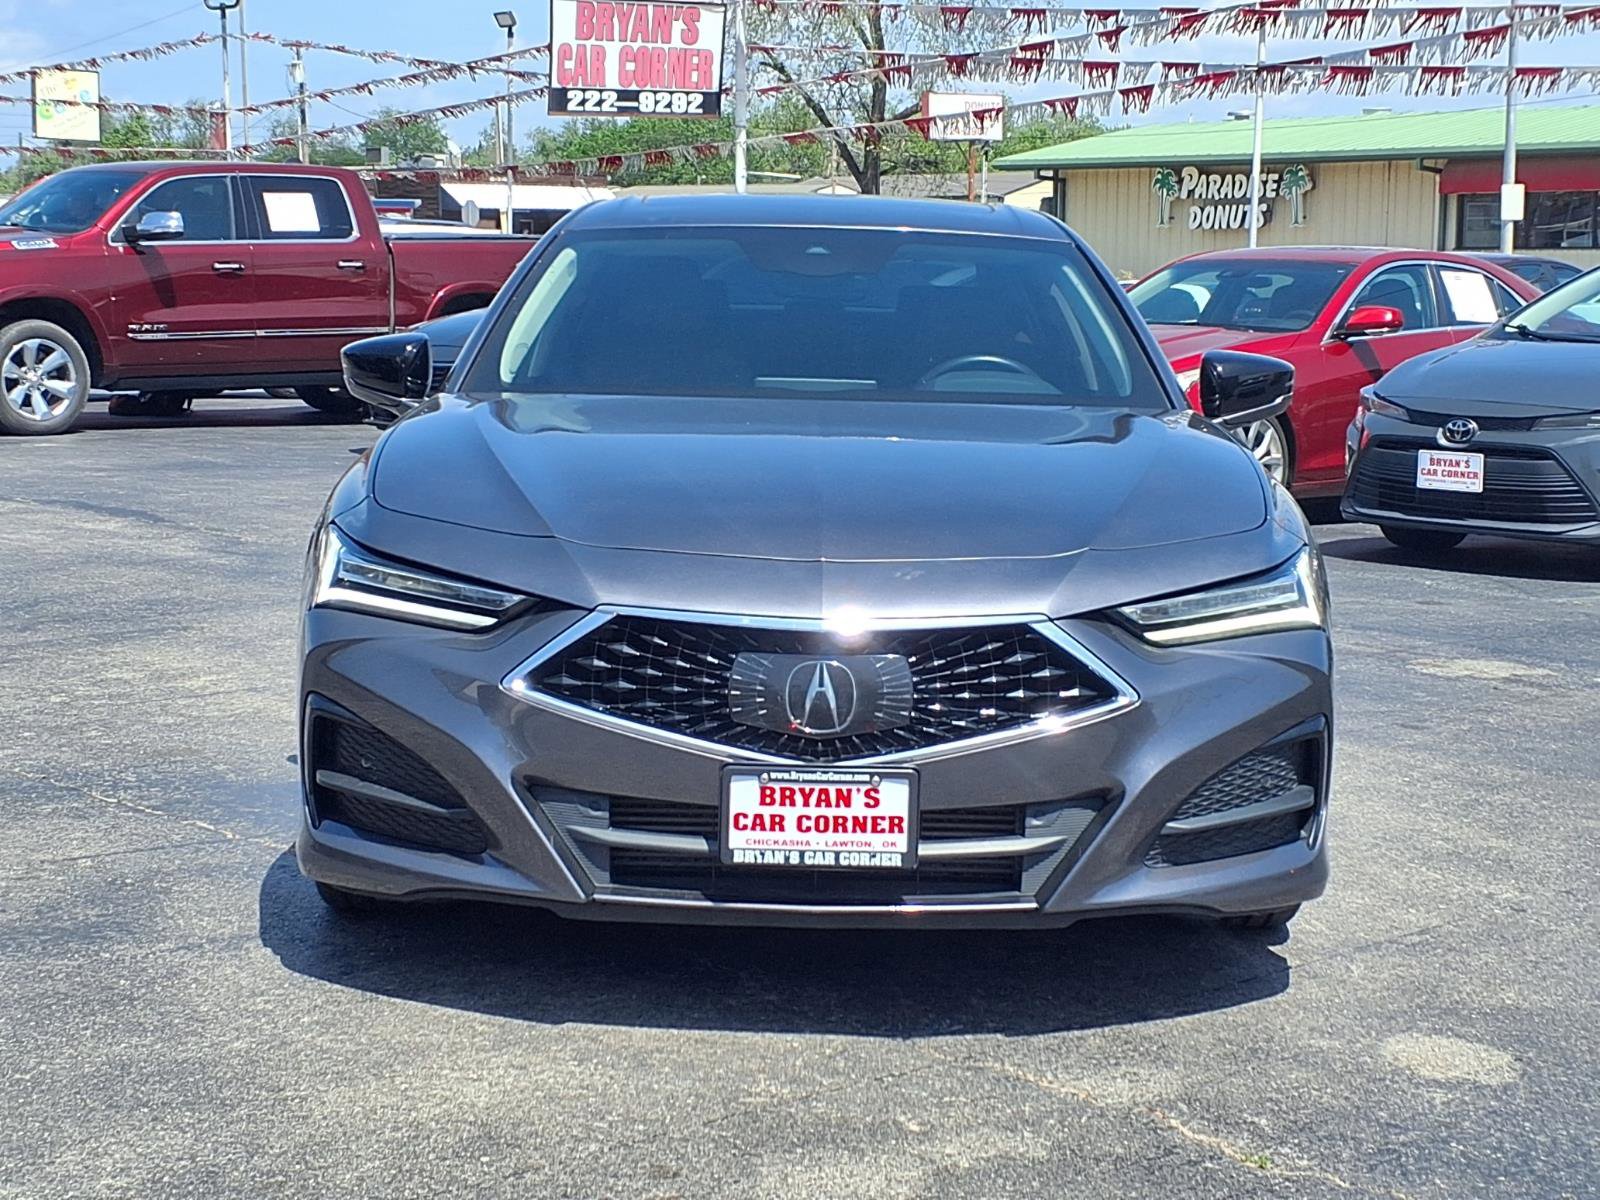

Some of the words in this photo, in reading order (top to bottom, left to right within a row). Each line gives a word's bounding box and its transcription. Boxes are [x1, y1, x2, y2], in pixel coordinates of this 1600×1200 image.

[575, 1, 701, 46] BRYAN'S
[556, 42, 607, 88] CAR
[617, 45, 714, 90] CORNER
[566, 90, 704, 113] 222-9292
[1188, 203, 1268, 230] DONUTS
[1421, 468, 1439, 476] CAR
[1441, 469, 1479, 479] CORNER
[1430, 458, 1471, 468] BRYAN'S
[759, 786, 881, 808] BRYAN'S
[733, 812, 786, 832] CAR
[796, 814, 905, 834] CORNER
[745, 838, 811, 847] CHICKASHA
[732, 850, 800, 864] BRYAN'S
[803, 851, 836, 865] CAR
[838, 851, 902, 867] CORNER
